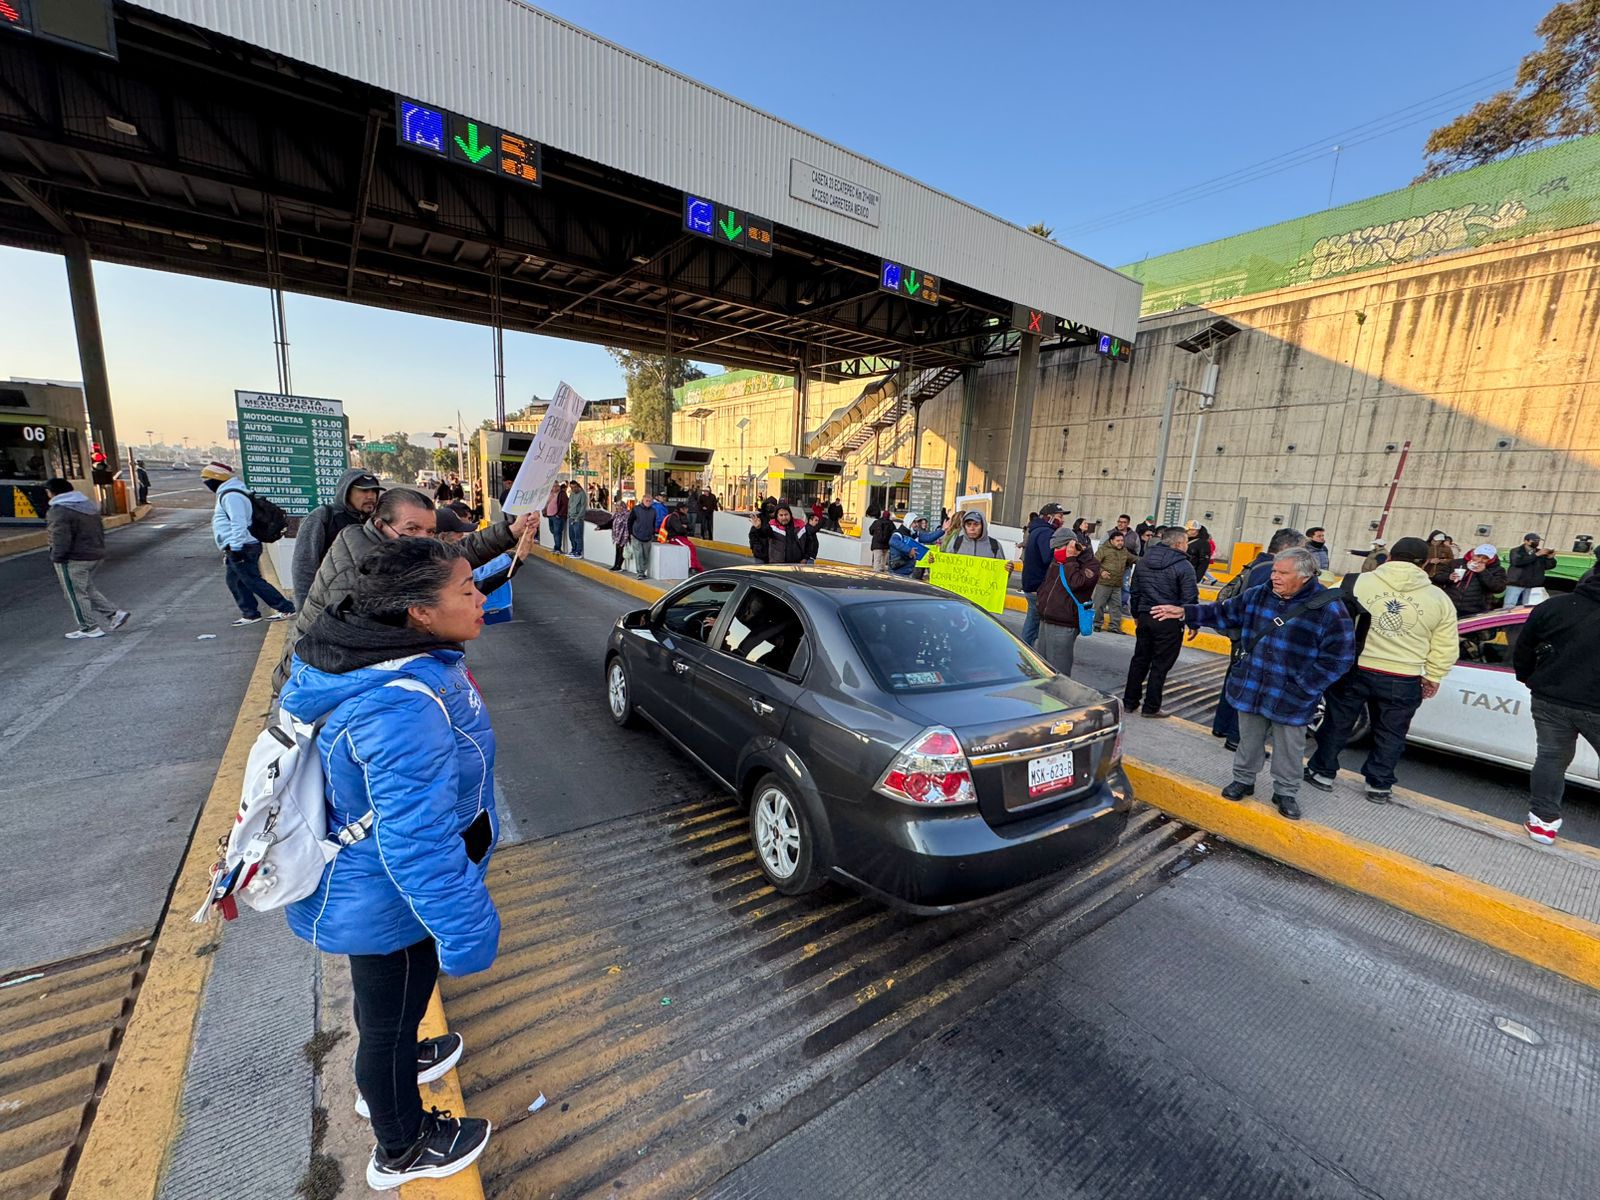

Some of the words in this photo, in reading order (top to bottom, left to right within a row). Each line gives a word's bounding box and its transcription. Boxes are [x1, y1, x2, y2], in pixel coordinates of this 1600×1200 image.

[811, 170, 828, 187] CASETA
[835, 179, 855, 197] ECATEPEC
[811, 187, 829, 204] ACCESO
[830, 193, 854, 213] CARRETERA
[854, 203, 869, 218] MEXICO
[245, 399, 335, 412] MEXICO-PACHUCA
[257, 395, 322, 406] AUTOPISTA
[243, 413, 304, 424] MOTOCICLETAS
[311, 419, 342, 428] $13.00
[23, 426, 45, 441] 06
[244, 423, 273, 432] AUTOS
[312, 429, 342, 438] $26.00
[245, 434, 275, 443] AUTOBUSES
[295, 437, 308, 445] EJES
[313, 438, 343, 448] $44.00
[246, 444, 267, 452] CAMION
[313, 448, 344, 458] $44.00
[247, 455, 270, 463] CAMION
[275, 456, 290, 464] EJES
[314, 458, 343, 467] $92.00
[248, 465, 271, 473] CAMION
[315, 467, 343, 477] $92.00
[249, 475, 272, 483] CAMION
[249, 486, 271, 494] CAMION
[317, 487, 335, 497] $126
[317, 497, 335, 505] $13
[952, 566, 969, 577] NOS
[980, 559, 999, 572] QUE
[1366, 592, 1424, 616] CARLSBAD
[1459, 689, 1521, 716] TAXI
[971, 743, 996, 753] AVEO
[998, 741, 1009, 750] LT
[1031, 761, 1072, 785] MSK-623-B
